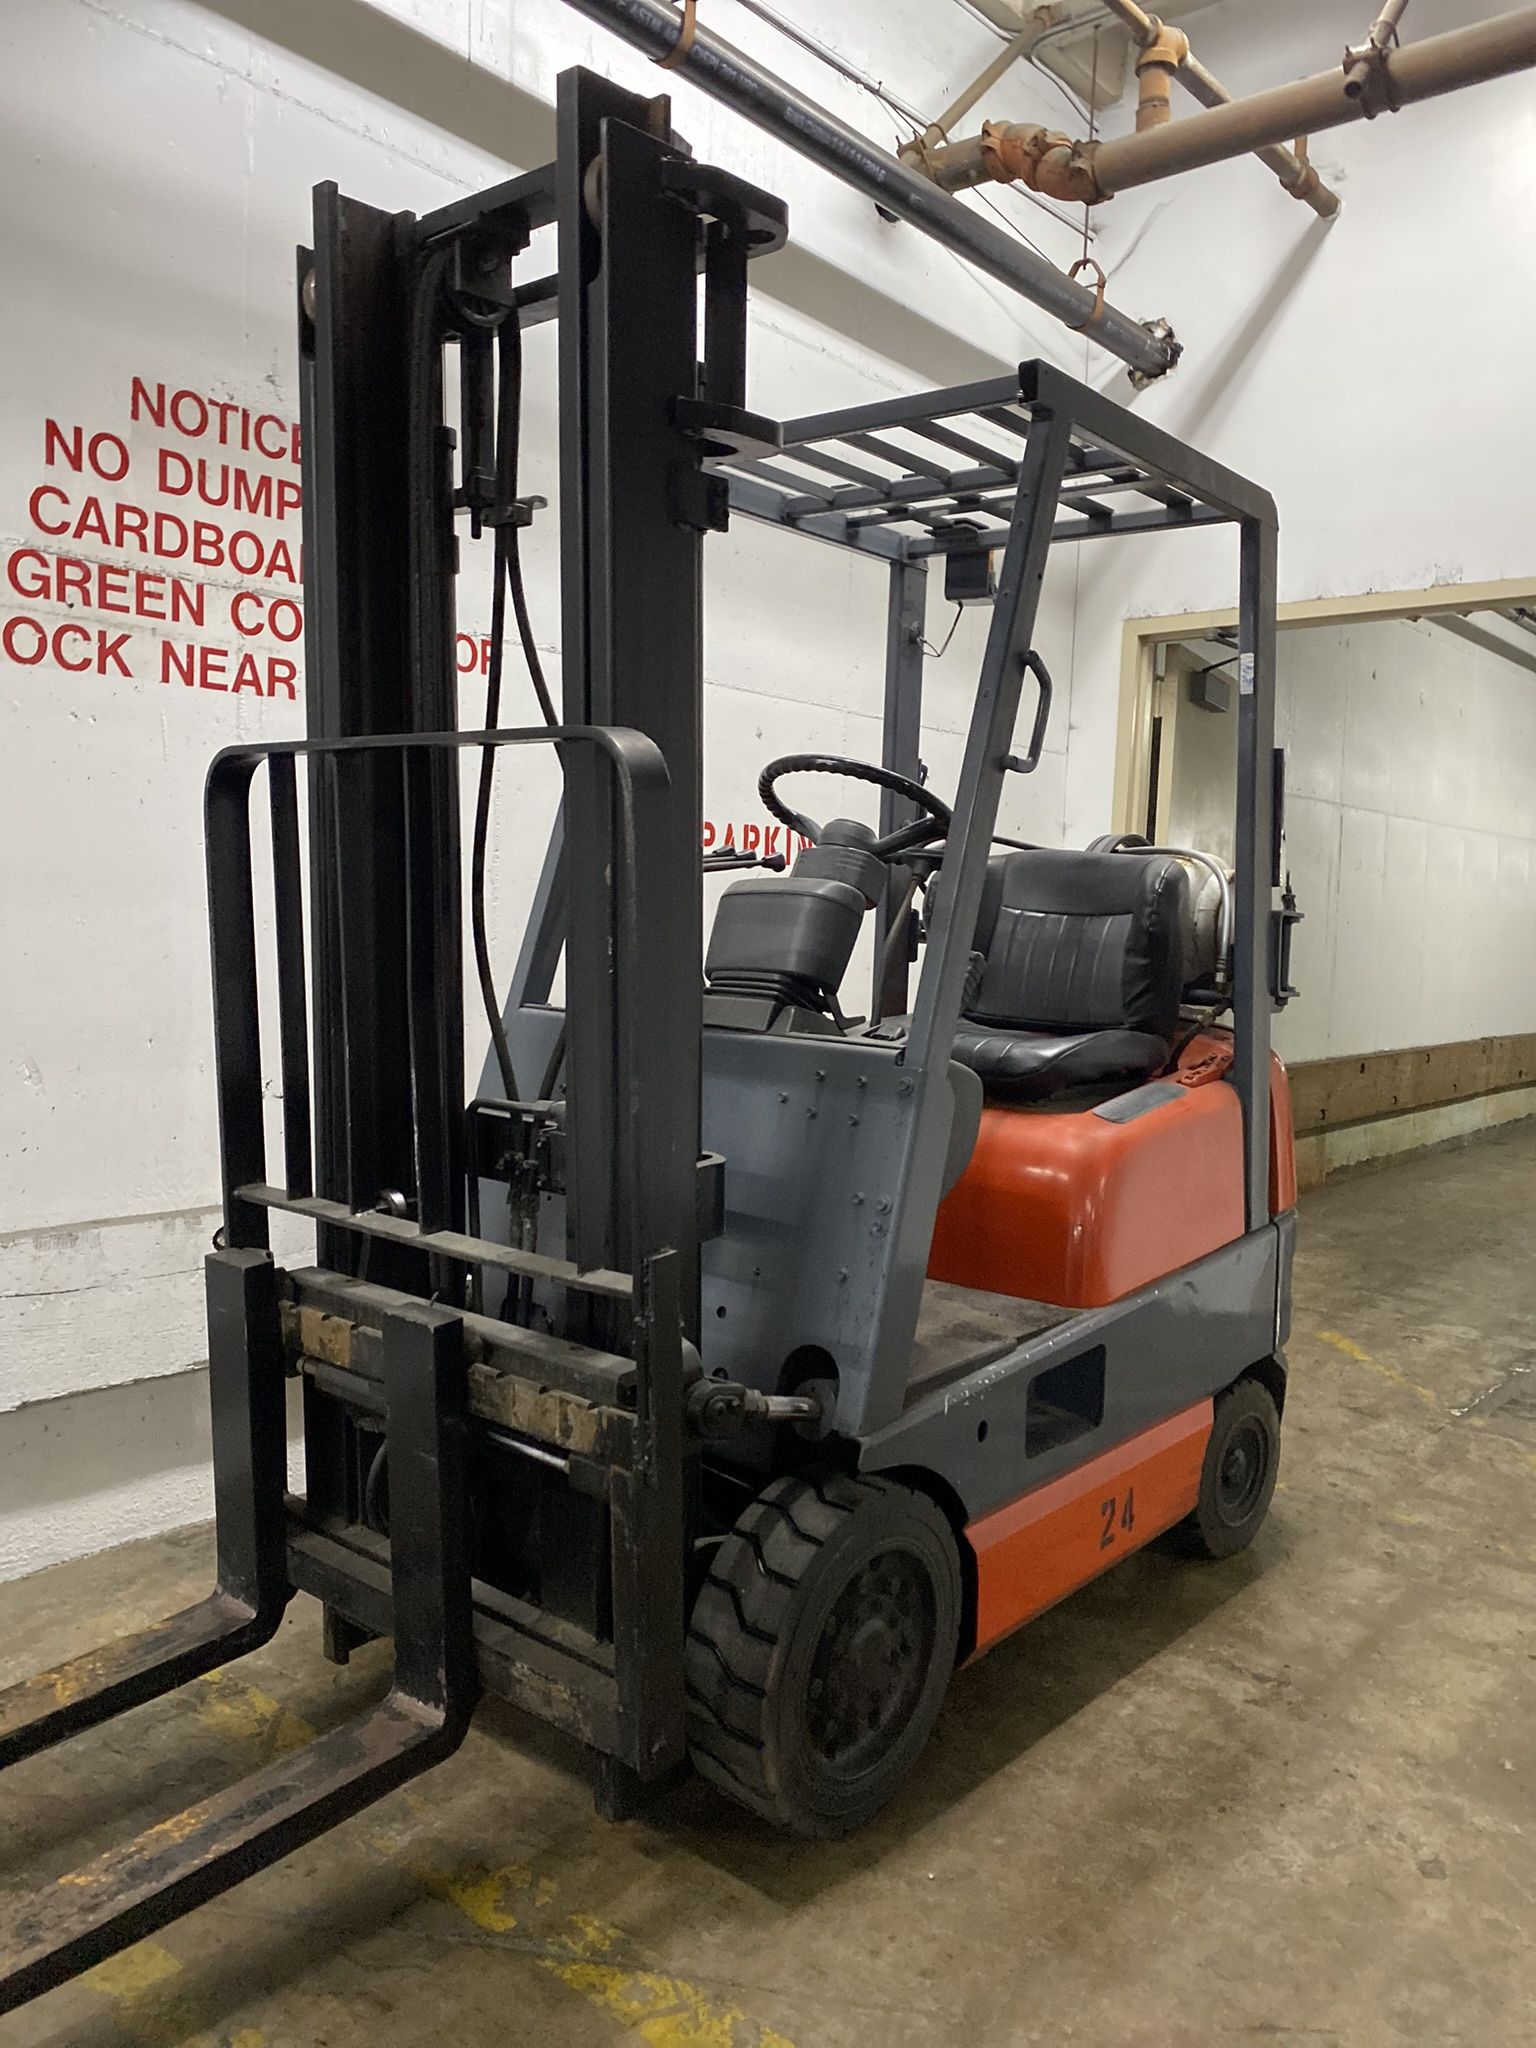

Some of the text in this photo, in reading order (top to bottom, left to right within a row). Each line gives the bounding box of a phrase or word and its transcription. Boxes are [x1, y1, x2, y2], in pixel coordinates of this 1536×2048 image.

[45, 418, 130, 482] NO
[7, 548, 205, 627] GREEN
[2, 616, 133, 678] OCK
[161, 640, 297, 700] NEAR
[1100, 1487, 1135, 1550] 24
